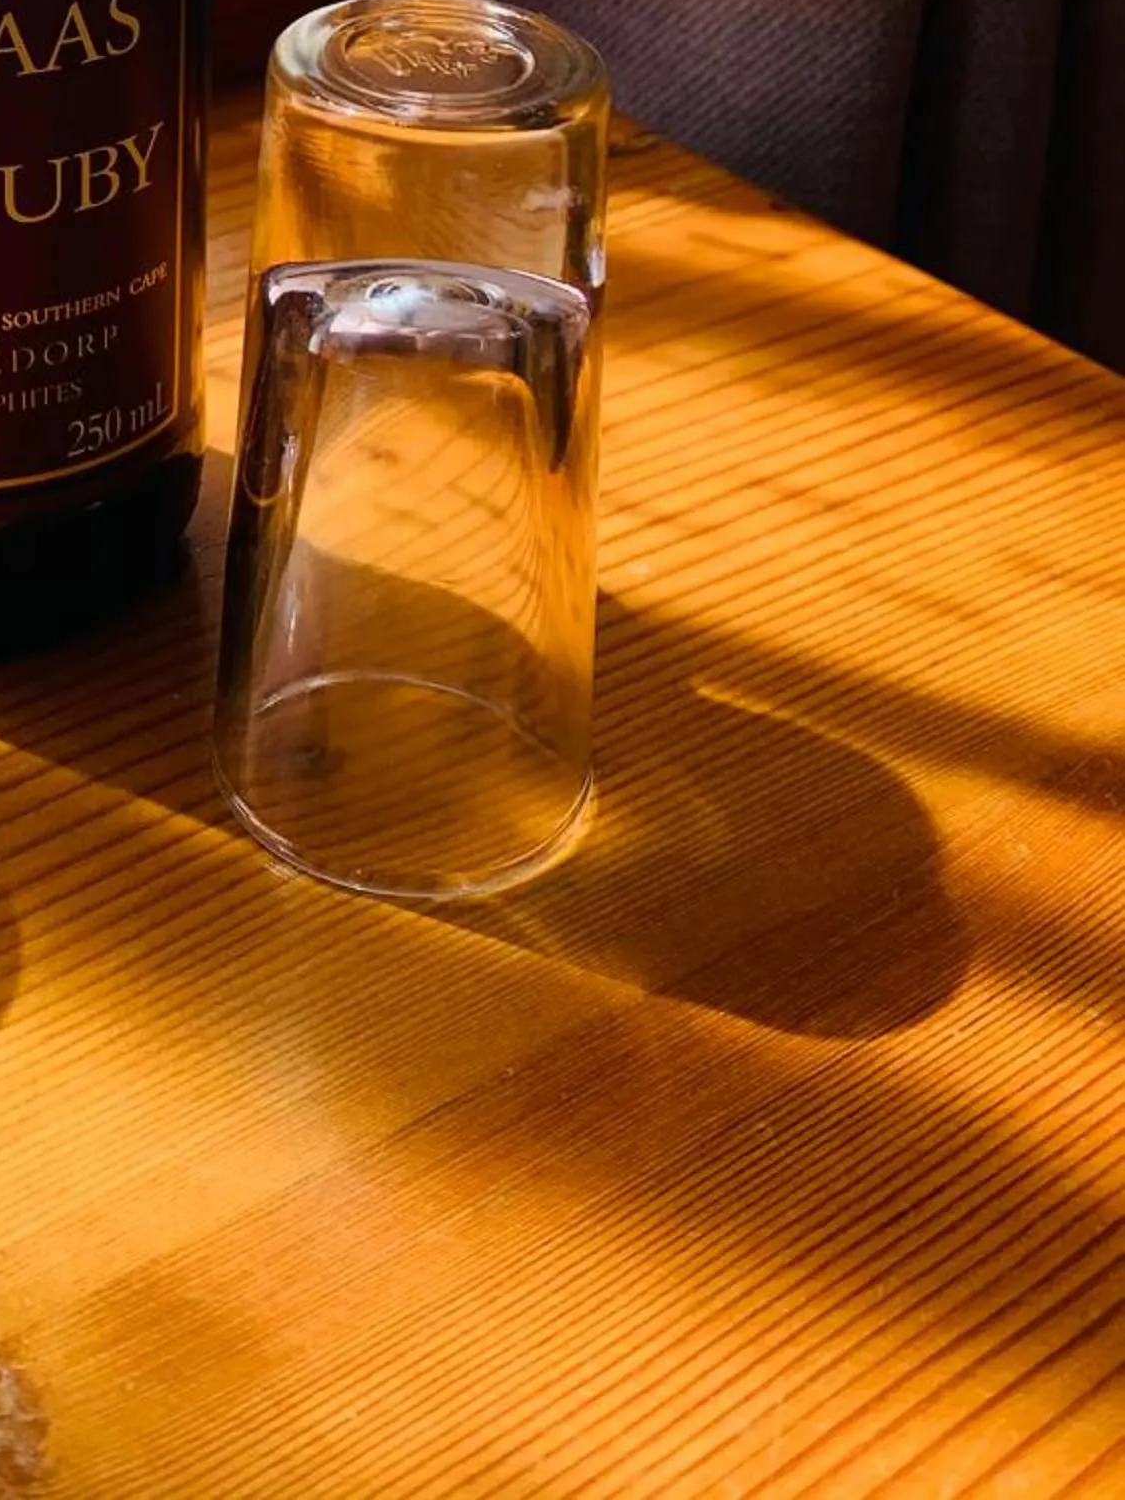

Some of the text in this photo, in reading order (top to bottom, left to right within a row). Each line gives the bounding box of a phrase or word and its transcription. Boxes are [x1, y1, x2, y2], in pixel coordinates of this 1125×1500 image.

[1, 287, 121, 331] SOUTHERN
[129, 261, 168, 295] CAPE
[67, 406, 122, 458] 250
